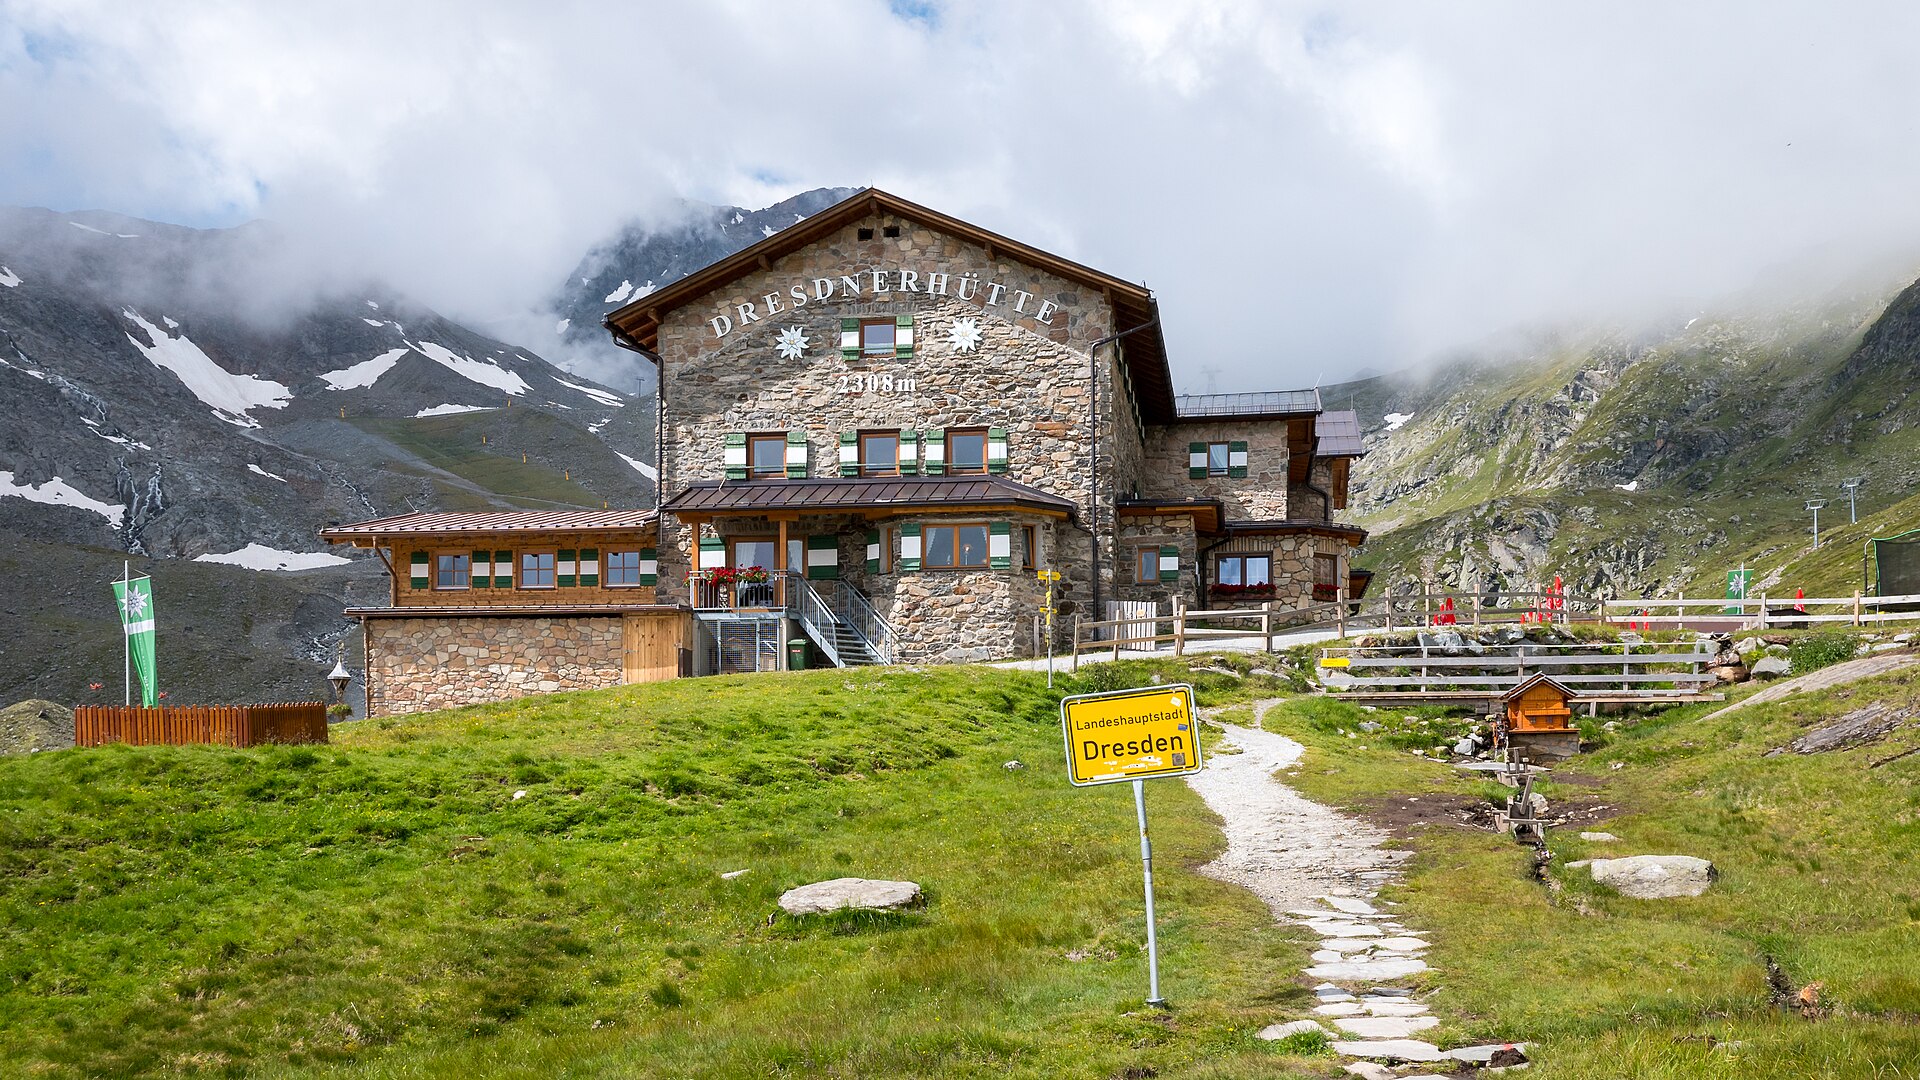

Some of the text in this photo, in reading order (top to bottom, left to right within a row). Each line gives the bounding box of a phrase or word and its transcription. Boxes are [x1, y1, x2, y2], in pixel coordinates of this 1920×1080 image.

[710, 270, 1059, 339] DRESDNERHÜTTE
[837, 374, 917, 394] 2308m
[1076, 709, 1184, 731] Landeshauptstadt
[1083, 734, 1184, 761] Dresden
